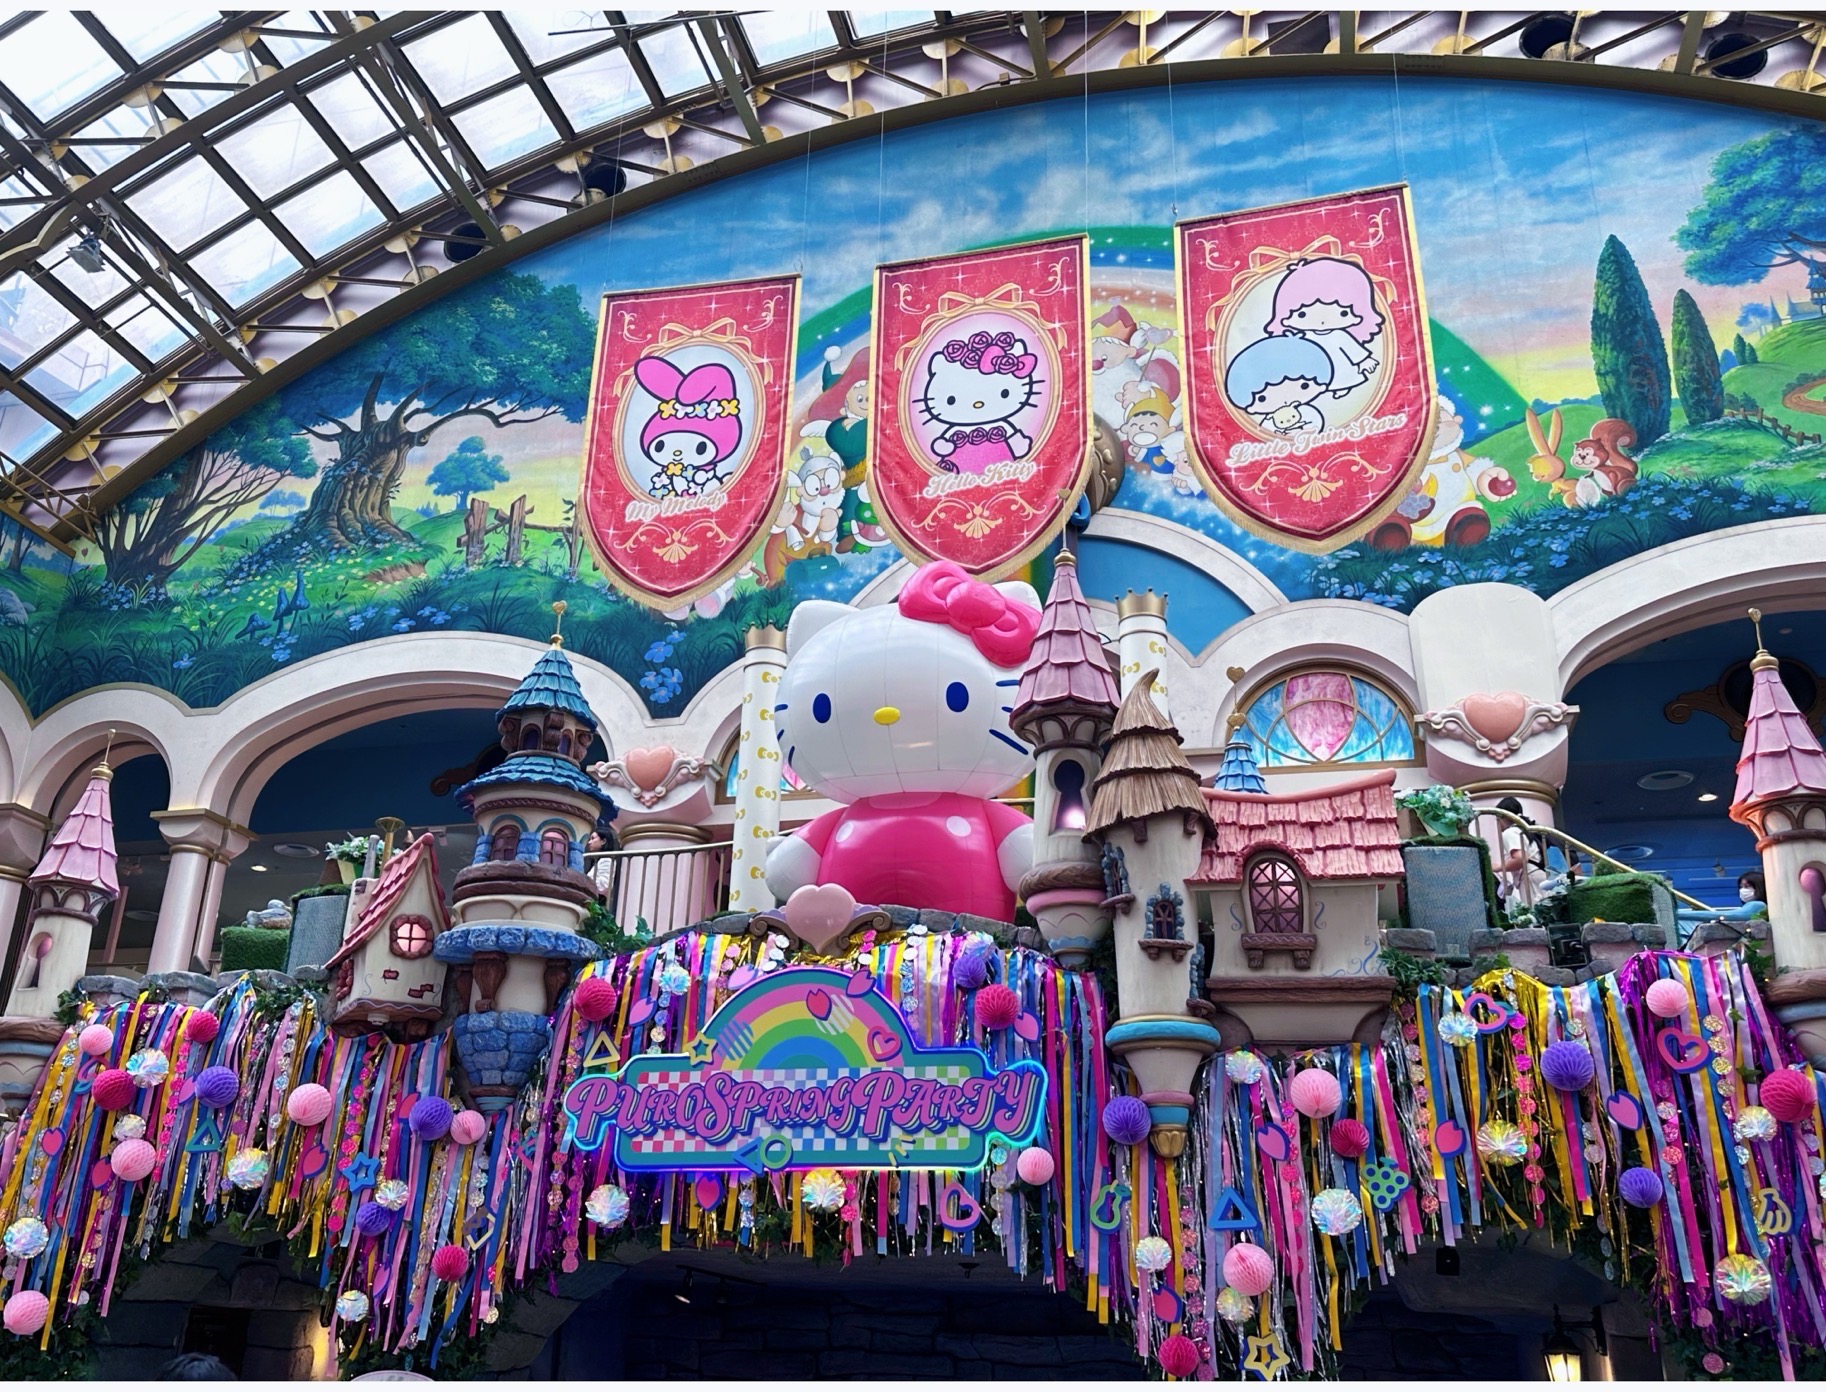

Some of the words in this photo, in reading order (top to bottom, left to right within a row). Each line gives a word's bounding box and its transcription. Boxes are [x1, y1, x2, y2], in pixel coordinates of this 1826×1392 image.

[1226, 440, 1291, 466] Little
[1294, 427, 1345, 453] Twin
[1349, 414, 1406, 440] Stars
[924, 472, 979, 498] Hello
[980, 461, 1035, 486] Kitty
[626, 502, 660, 522] My
[662, 491, 727, 517] Melody
